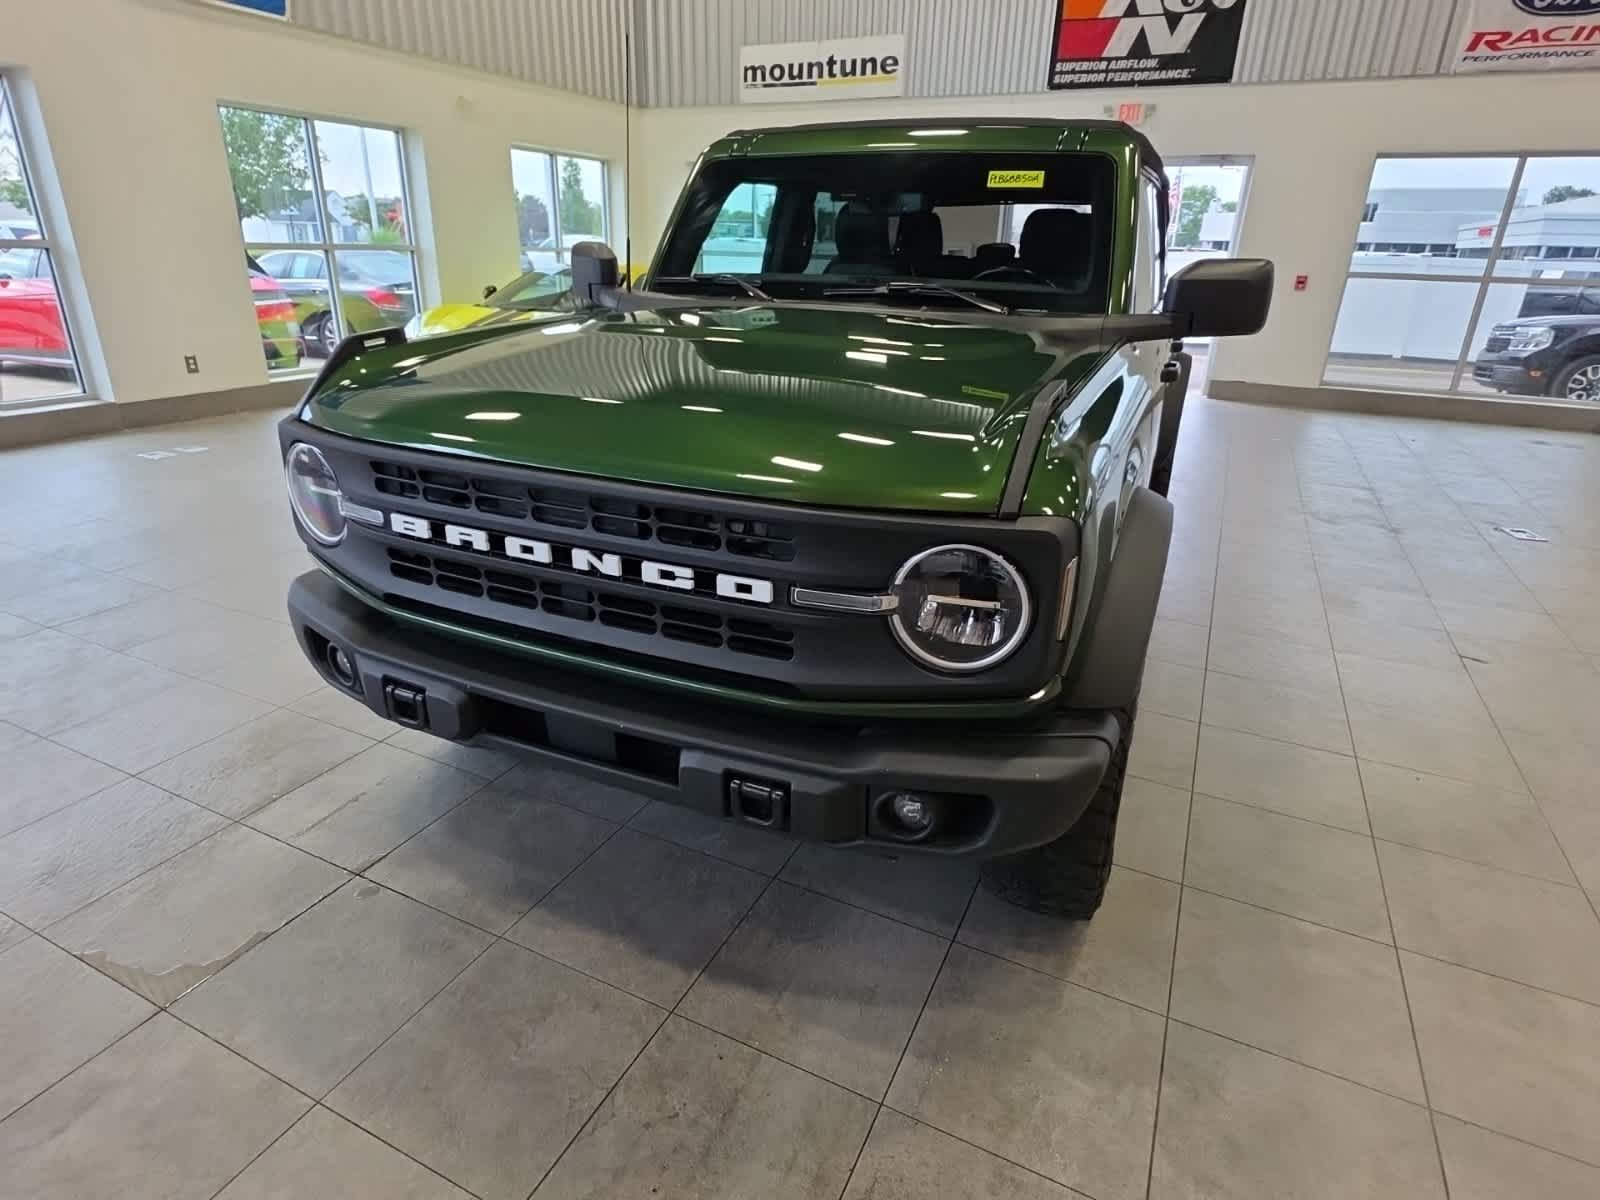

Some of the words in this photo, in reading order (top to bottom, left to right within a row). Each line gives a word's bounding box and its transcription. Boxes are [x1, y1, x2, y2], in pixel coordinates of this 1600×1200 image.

[1463, 49, 1599, 62] PERFORMANCE
[743, 54, 899, 82] mountune
[1055, 60, 1108, 72] SUPERIOR
[1108, 58, 1160, 70] AIRFLOW.
[1053, 72, 1106, 84] SUPERIOR
[1119, 104, 1142, 121] EXIT
[391, 513, 774, 603] BRONCO
